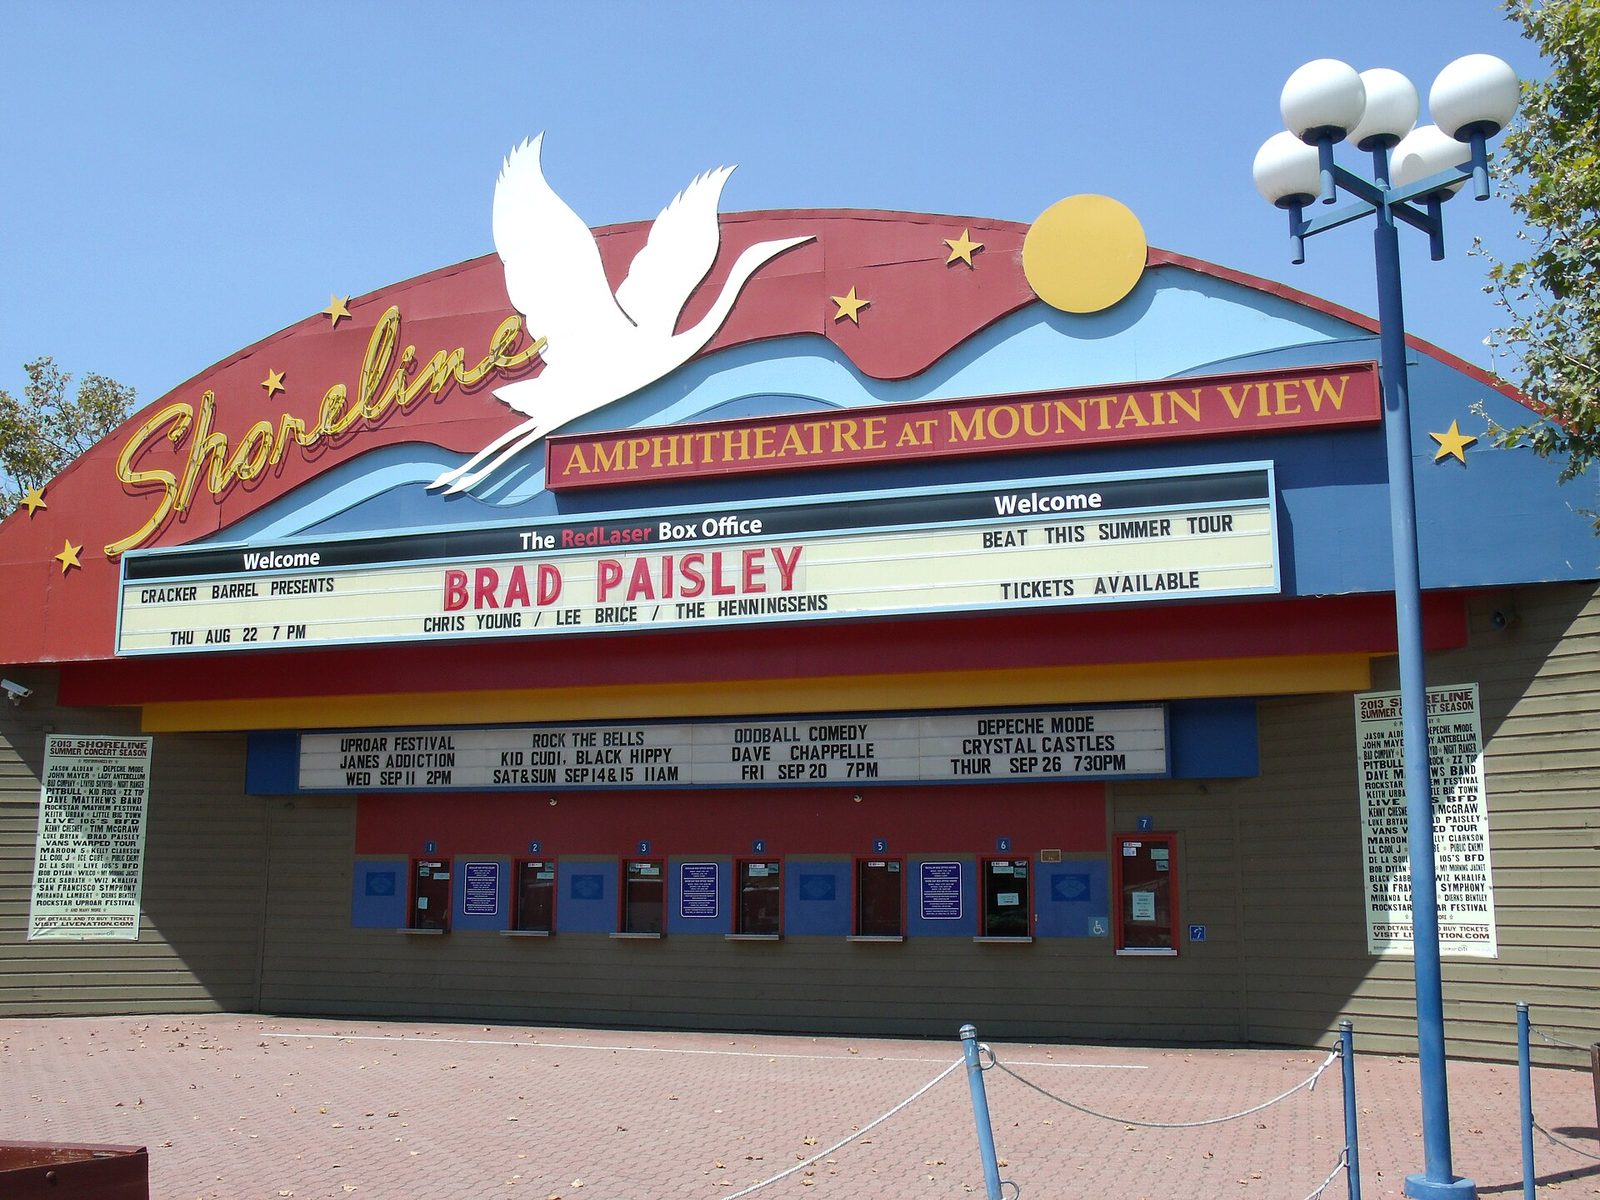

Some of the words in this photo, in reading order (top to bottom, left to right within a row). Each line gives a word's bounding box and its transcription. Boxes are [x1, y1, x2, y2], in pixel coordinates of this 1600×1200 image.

[103, 305, 548, 555] Shoreline
[562, 417, 888, 476] AMPHITHEATRE
[897, 419, 939, 446] AT
[947, 389, 1203, 442] MOUNTAIN
[1217, 375, 1351, 419] VIEW
[994, 491, 1103, 515] Welcome
[520, 531, 556, 551] The
[561, 525, 652, 548] RedLaser
[658, 521, 699, 542] Box
[700, 516, 764, 538] Office
[982, 529, 1028, 549] BEAT
[1044, 524, 1085, 545] THIS
[1099, 519, 1172, 541] SUMMER
[1186, 515, 1233, 535] TOUR
[243, 549, 320, 572] Welcome
[444, 563, 563, 612] BRAD
[597, 545, 803, 603] PAISLEY
[1000, 579, 1074, 601] TICKETS
[1094, 571, 1200, 595] AVAILABLE
[140, 585, 197, 605] CRACKER
[211, 581, 259, 600] BARREL
[270, 577, 334, 596] PRESENTS
[423, 615, 465, 634] CHRIS
[476, 612, 522, 630] YOUNG
[556, 609, 582, 626] LEE
[594, 606, 638, 624] BRICE
[676, 602, 705, 620] THE
[718, 594, 828, 618] HENNINGSENS
[170, 630, 195, 646] THU
[204, 628, 232, 645] AUG
[242, 627, 258, 643] 22
[272, 626, 281, 641] 7
[287, 625, 307, 641] PM
[1360, 700, 1383, 710] 2013
[1361, 708, 1396, 719] SUMMER
[1440, 701, 1474, 712] SEASON
[734, 727, 800, 743] ODDBALL
[809, 724, 868, 741] COMEDY
[978, 718, 1044, 735] DEPECHE
[1051, 716, 1094, 733] MODE
[1454, 724, 1472, 732] MODE
[77, 741, 147, 749] SHORELINE
[341, 738, 387, 752] UPROAR
[394, 736, 455, 751] FESTIVAL
[532, 733, 566, 748] ROCK
[572, 732, 597, 747] THE
[603, 731, 644, 746] BELLS
[963, 738, 1036, 755] CRYSTAL
[1042, 735, 1114, 752] CASTLES
[1438, 733, 1476, 743] ANTEBELLUM
[501, 751, 523, 766] KID
[531, 751, 567, 766] CUDI,
[576, 749, 622, 765] BLACK
[631, 748, 672, 764] HIPPY
[732, 746, 770, 761] DAVE
[790, 743, 874, 760] CHAPPELLE
[340, 755, 379, 769] JANES
[386, 753, 455, 768] ADDICTION
[951, 758, 991, 774] THUR
[1010, 756, 1038, 774] SEP
[1042, 756, 1061, 772] 26
[1074, 755, 1126, 771] 730PM
[1364, 759, 1403, 770] PITBULL
[1453, 755, 1462, 764] ZZ
[1467, 754, 1478, 762] TOP
[346, 772, 370, 786] WED
[427, 771, 451, 784] 2PM
[493, 769, 556, 783] SAT&SUN
[645, 766, 678, 781] 11AM
[742, 765, 764, 780] FRI
[778, 764, 805, 779] SEP
[810, 764, 827, 778] 20
[846, 762, 878, 778] 7PM
[1366, 771, 1388, 781] DAVE
[1450, 765, 1476, 776] BAND
[1365, 781, 1403, 789] ROCKSTAR
[1444, 776, 1478, 785] FESTIVAL
[46, 796, 67, 804] DAVE
[72, 796, 116, 804] MATTHEWS
[1367, 790, 1386, 798] KEITH
[1142, 820, 1147, 828] 7
[1446, 815, 1480, 823] PAISLEY
[532, 844, 538, 852] 2
[641, 844, 647, 852] 3
[756, 843, 762, 851] 4
[878, 842, 883, 850] 5
[1000, 841, 1006, 850] 6
[1368, 836, 1407, 844] MAROON
[1373, 883, 1388, 892] SAN
[1441, 883, 1485, 892] SYMPHONY
